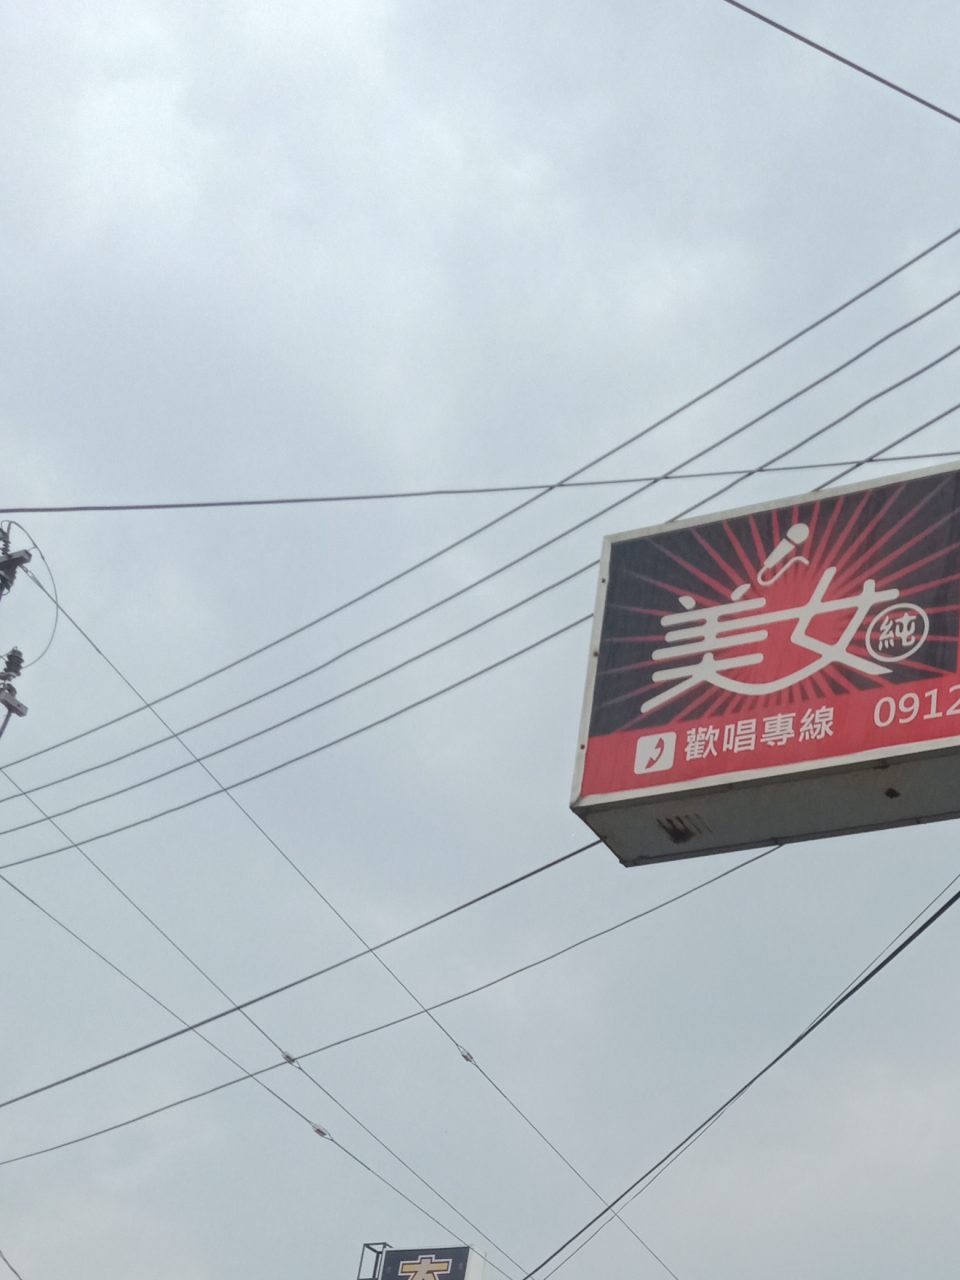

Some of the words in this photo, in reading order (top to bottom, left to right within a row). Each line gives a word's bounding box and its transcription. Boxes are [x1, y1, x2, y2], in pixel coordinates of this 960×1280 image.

[641, 567, 900, 713] 美女
[874, 606, 923, 655] 純
[684, 706, 834, 762] 歡唱專線
